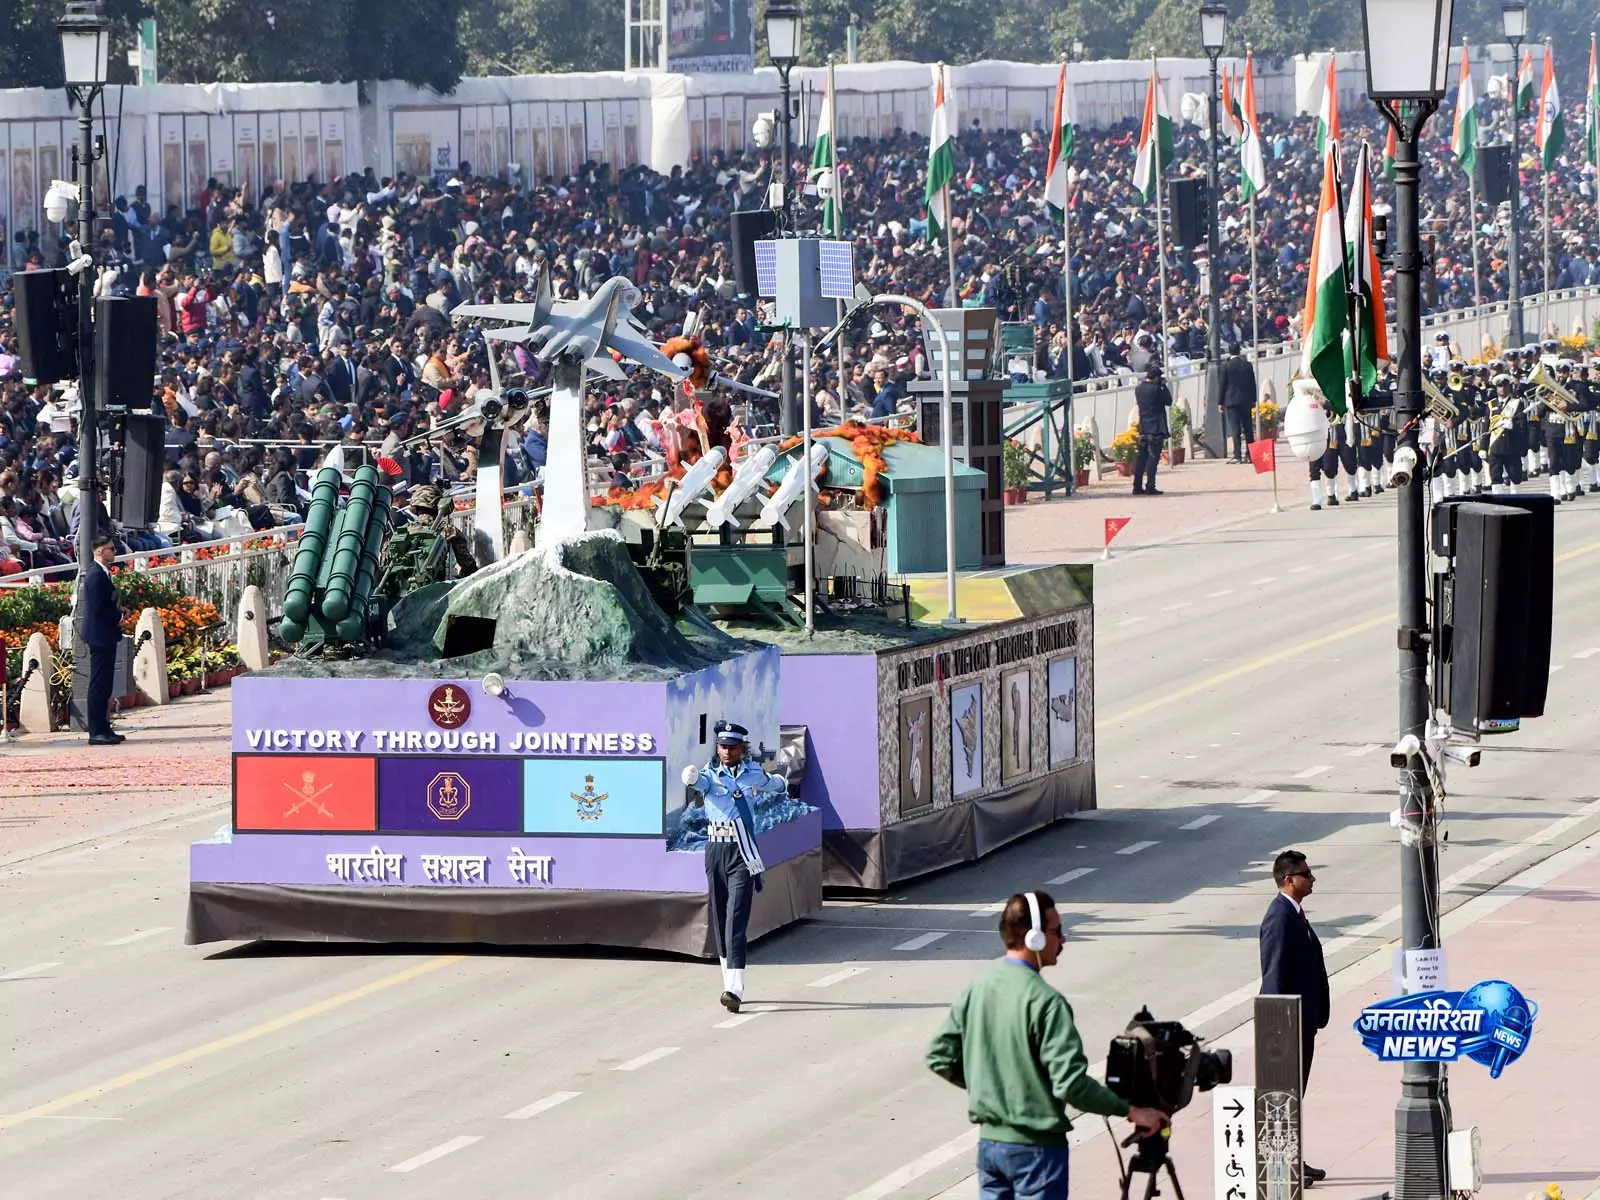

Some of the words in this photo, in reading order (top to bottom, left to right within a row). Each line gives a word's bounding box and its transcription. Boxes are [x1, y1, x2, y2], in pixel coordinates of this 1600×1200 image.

[954, 641, 992, 676] VICTORY
[995, 630, 1033, 665] THROUGH
[245, 729, 363, 749] VICTORY
[372, 731, 497, 751] THROUGH
[509, 732, 655, 752] JOINTNESS
[326, 845, 404, 880] भारतीय
[420, 855, 488, 882] सशस्त्र
[507, 847, 553, 882] सेना
